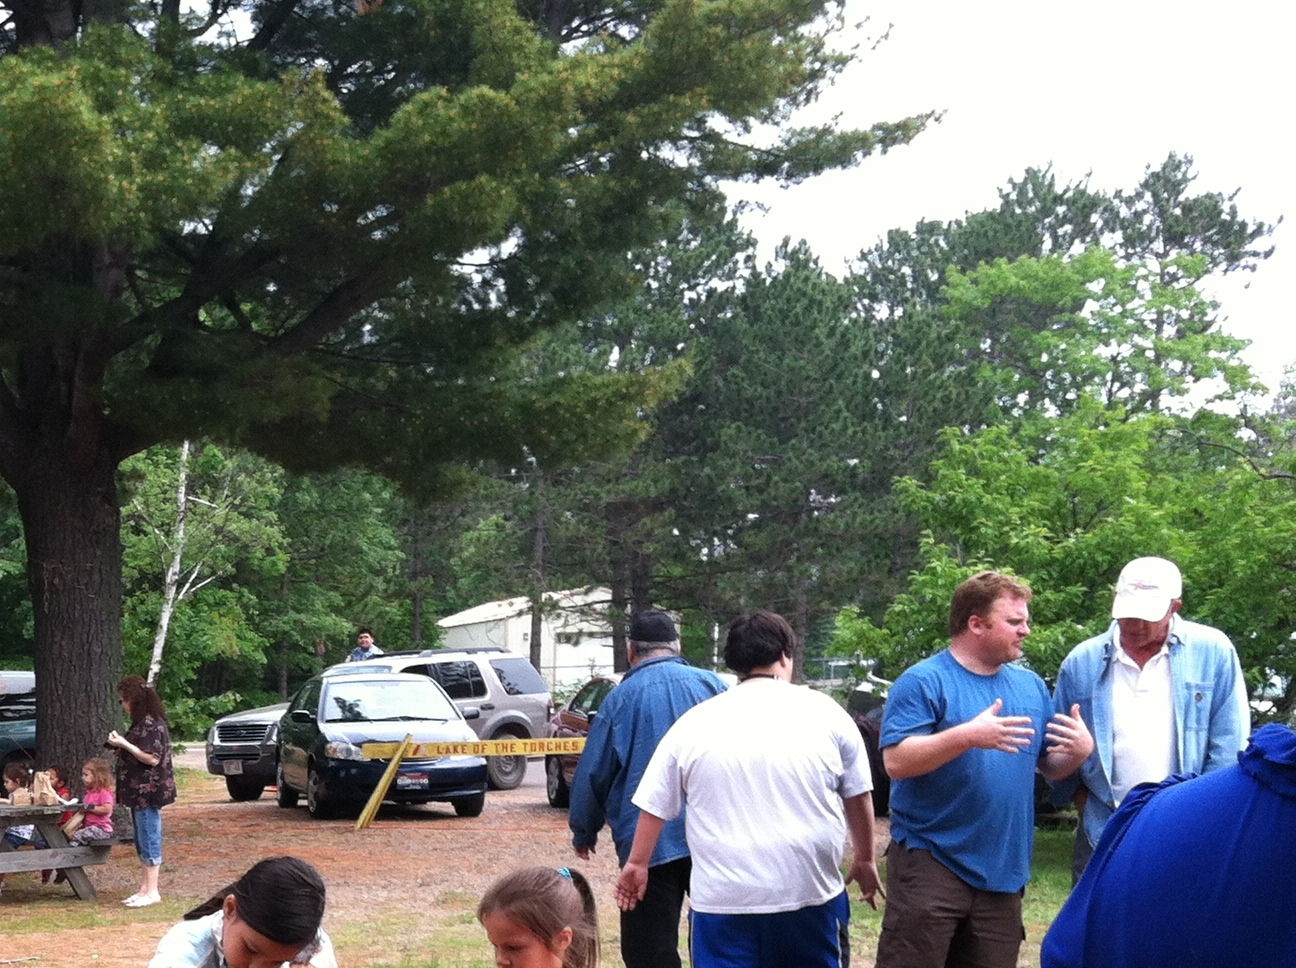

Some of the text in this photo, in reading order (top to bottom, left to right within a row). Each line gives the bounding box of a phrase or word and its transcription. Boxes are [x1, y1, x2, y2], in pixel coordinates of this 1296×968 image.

[437, 741, 579, 755] LAKE OF THE TORCHES
